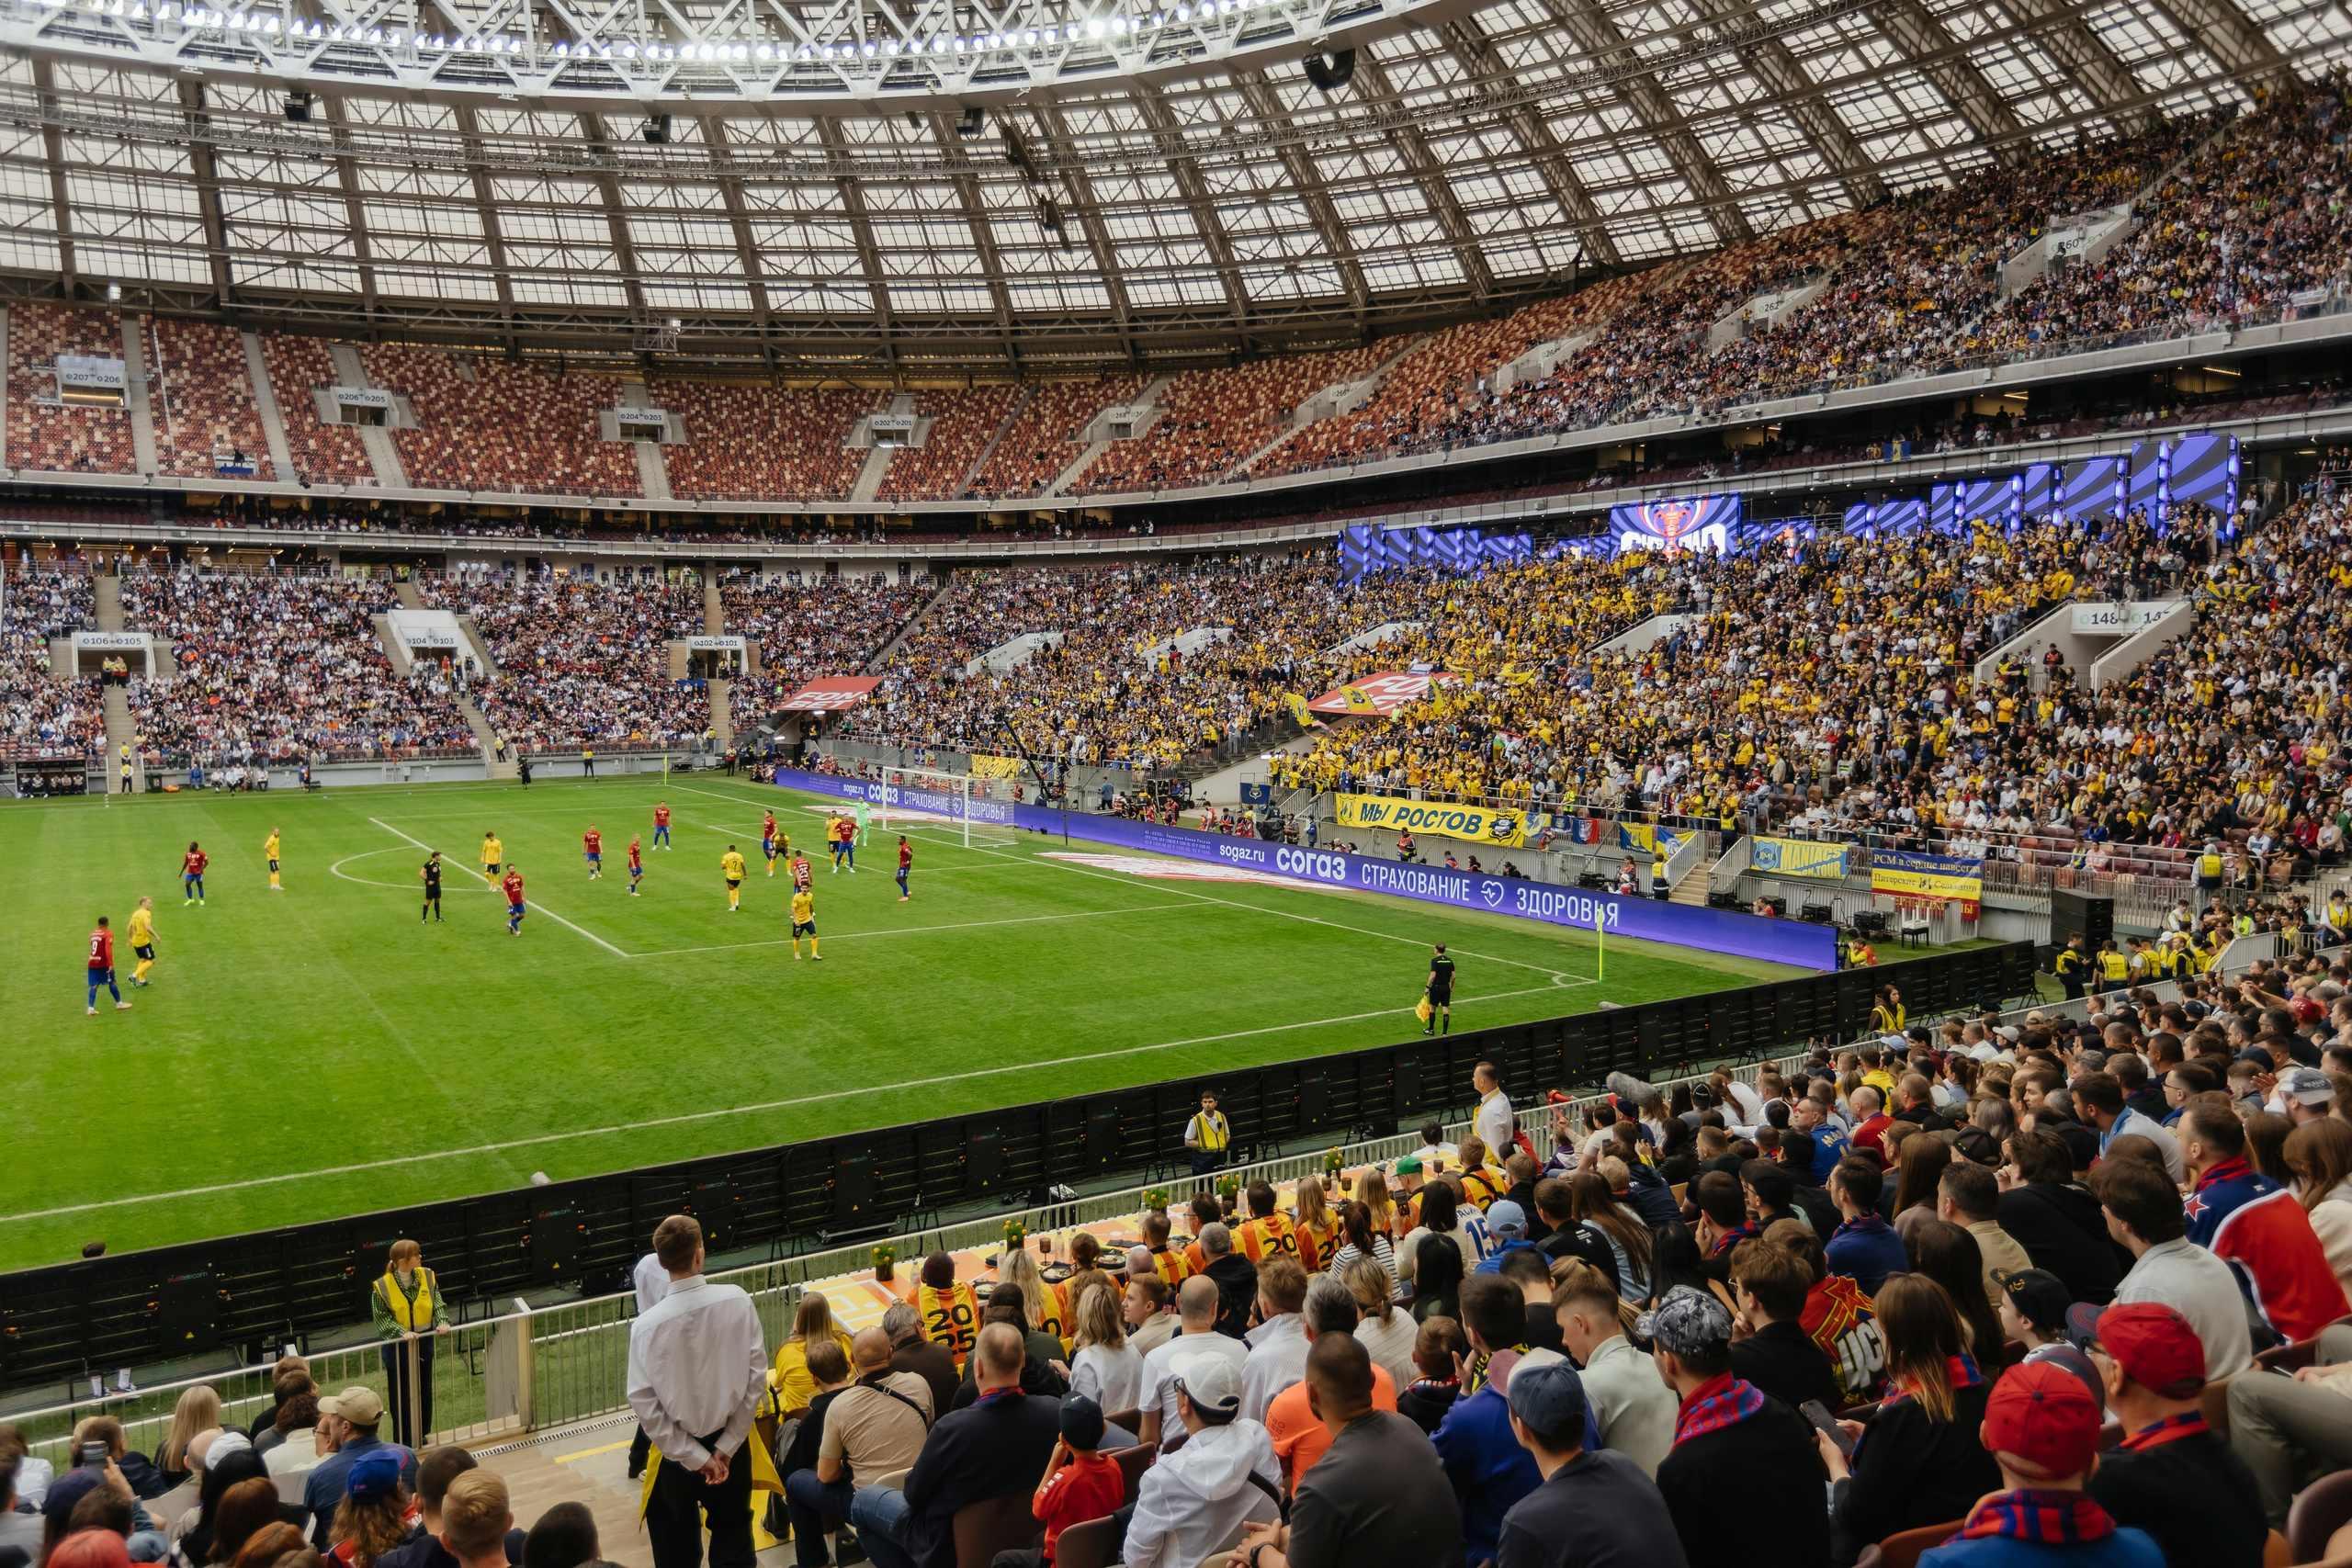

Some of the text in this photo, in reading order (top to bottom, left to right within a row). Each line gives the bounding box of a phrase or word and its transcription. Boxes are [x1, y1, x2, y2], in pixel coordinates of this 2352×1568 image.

[1764, 301, 1779, 311] 262
[73, 373, 120, 384] 207 206
[2091, 612, 2119, 625] 148
[91, 637, 109, 645] 106
[782, 699, 854, 709] BET
[794, 691, 865, 701] FON
[842, 784, 865, 796] sogaz.ru
[868, 784, 899, 804] соаз
[904, 791, 949, 812] СТРАХОВАНИЕ
[1360, 802, 1391, 822] МЫ
[1393, 806, 1483, 835] РОСТОВ
[1219, 844, 1265, 863] sogaz.ru
[1780, 841, 1843, 872] MANIACS
[732, 860, 738, 871] 7
[798, 866, 808, 878] 25
[1815, 860, 1841, 878] TOUR
[1874, 853, 1896, 865] РСМ
[1905, 858, 1938, 870] сердце
[1939, 862, 1981, 874] навсегда
[1874, 873, 1977, 893] Питерские Сельмаши
[1362, 863, 1619, 927] СТРАХОВАНИЕ ЗДОРОВЬЯ
[92, 941, 98, 955] 9
[537, 1208, 571, 1219] trusttelecom
[1262, 1233, 1297, 1256] 20
[1317, 1234, 1342, 1262] 20
[1464, 1217, 1498, 1261] 15
[167, 1270, 209, 1284] trusttelecom
[927, 1303, 973, 1334] 20
[933, 1326, 978, 1356] 25
